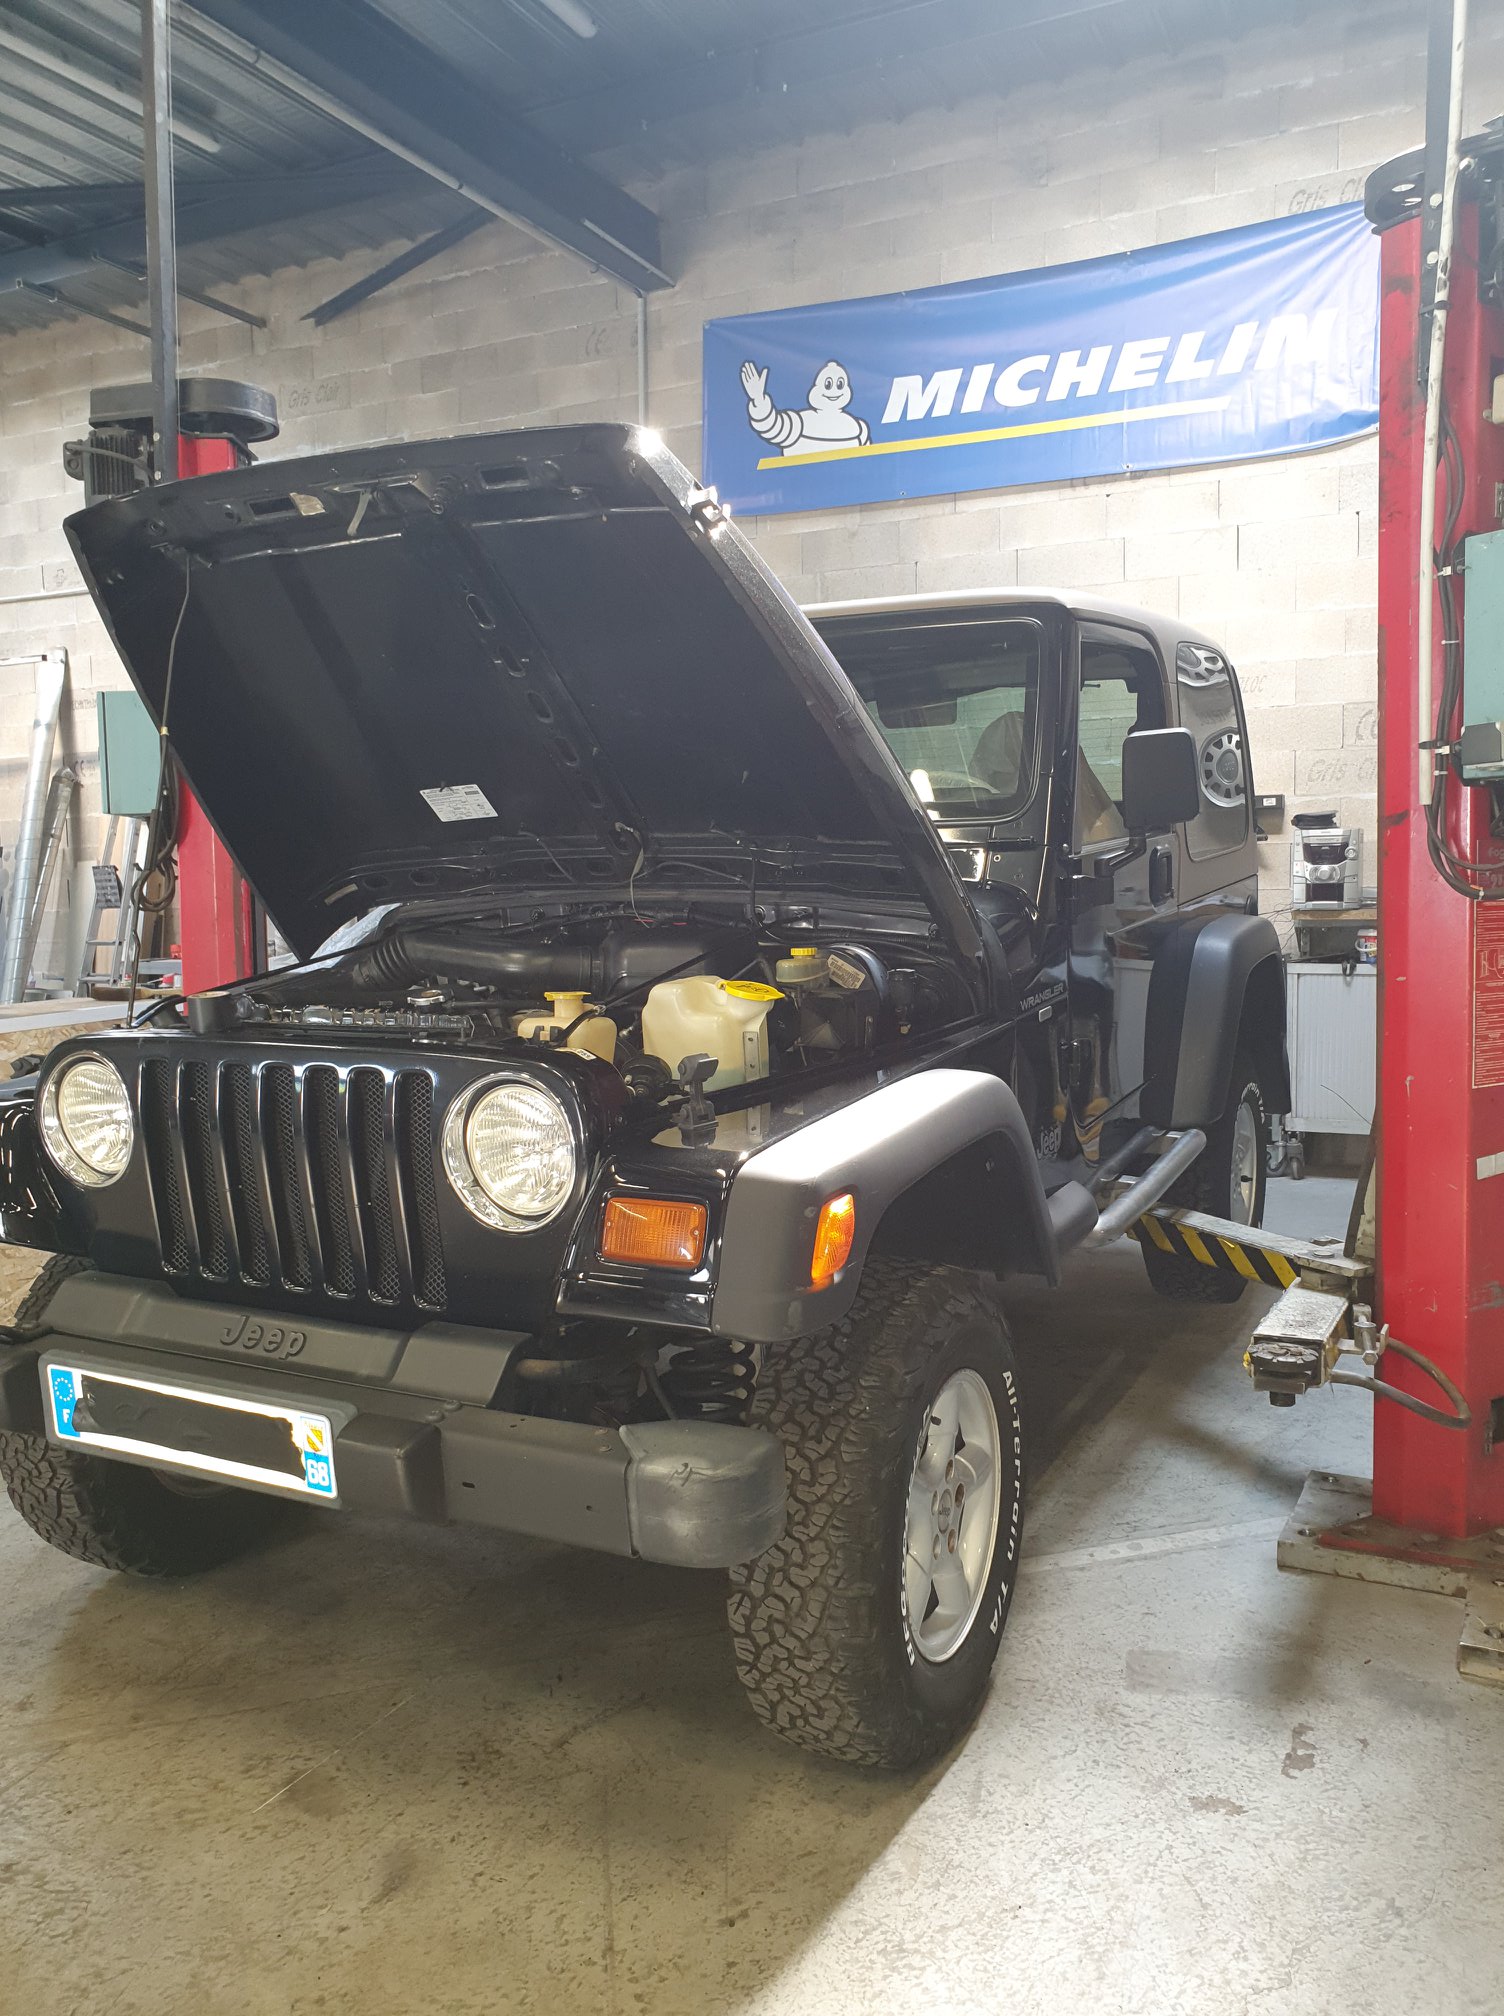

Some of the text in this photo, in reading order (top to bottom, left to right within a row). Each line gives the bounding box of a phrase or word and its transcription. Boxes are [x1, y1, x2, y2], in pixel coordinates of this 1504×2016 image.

[881, 307, 1338, 425] MICHELIN
[1020, 983, 1064, 1011] WRANGLER
[1036, 1125, 1062, 1160] Jeep
[219, 1314, 309, 1361] Jeep
[62, 1408, 71, 1424] F
[306, 1458, 330, 1487] 68
[1002, 1370, 1021, 1562] All-Terrain
